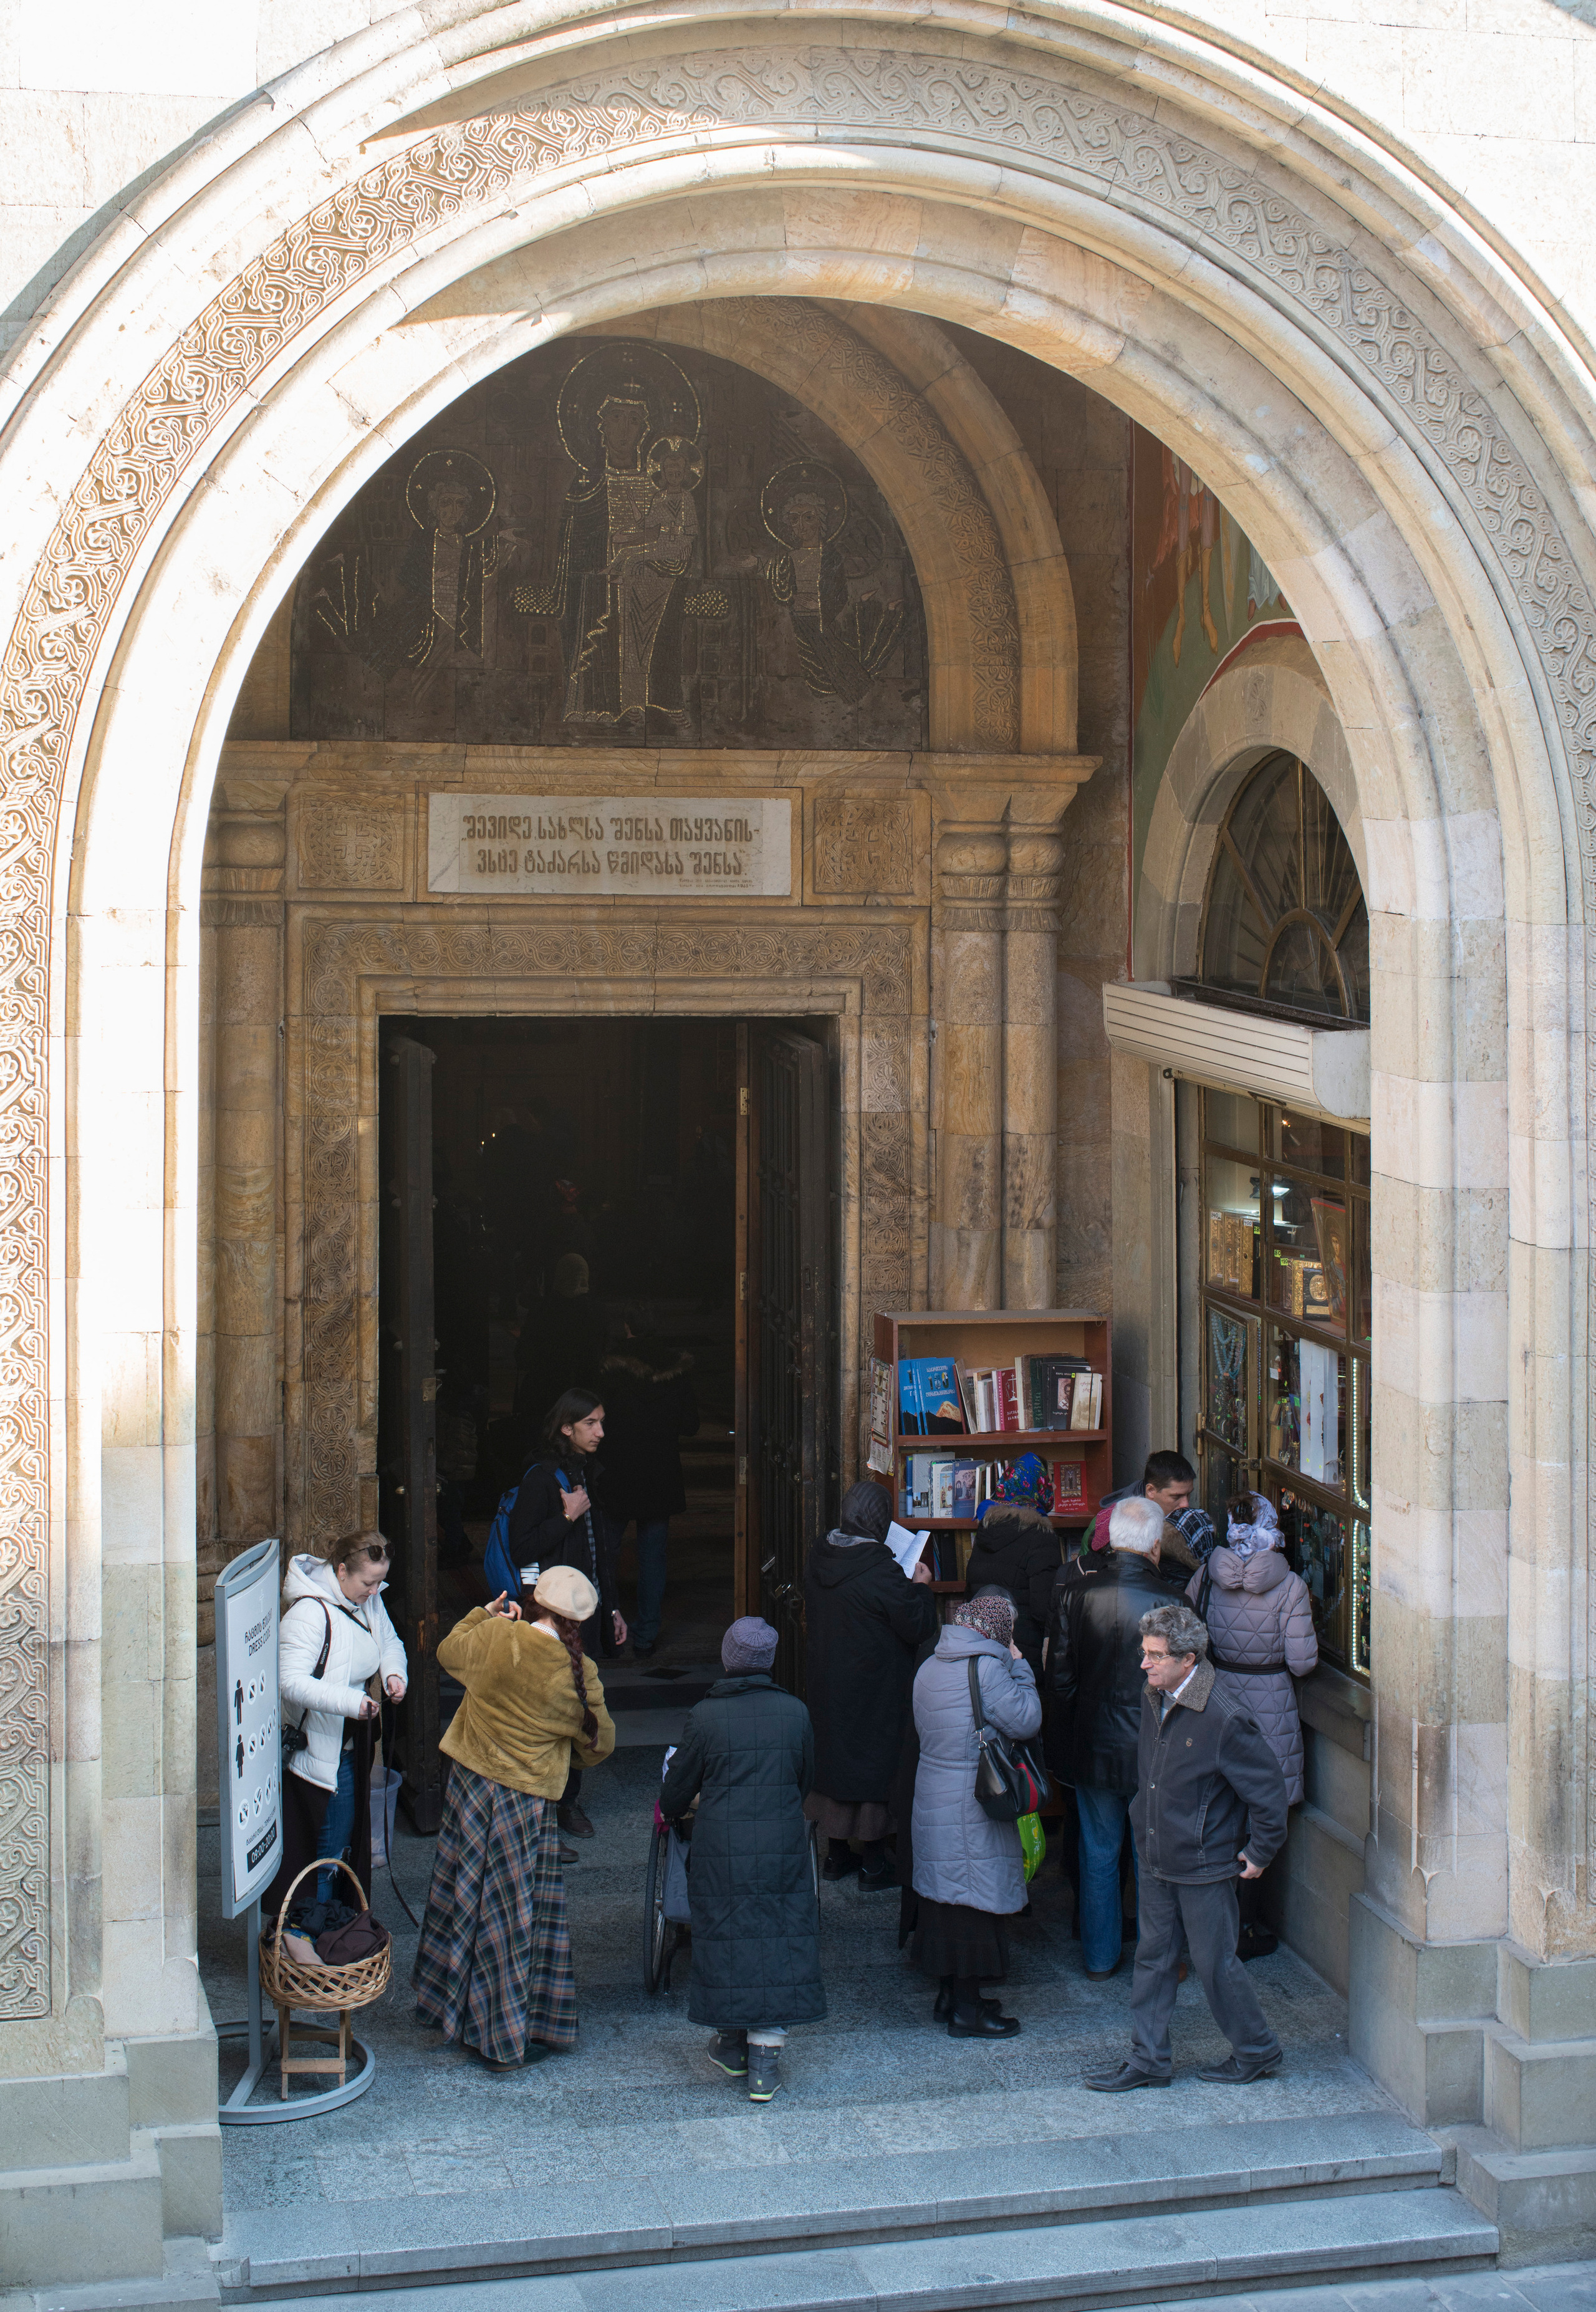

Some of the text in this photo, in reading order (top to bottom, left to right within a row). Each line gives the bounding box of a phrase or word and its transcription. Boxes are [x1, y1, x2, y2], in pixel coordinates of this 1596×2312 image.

[538, 816, 604, 841] სახლსა
[477, 849, 518, 874] ვსცე
[524, 849, 601, 874] ტაძარსა
[607, 850, 684, 875] წმიდასა
[249, 1635, 263, 1657] DRESS
[320, 1642, 329, 1665] Canon
[251, 1826, 276, 1863] 09:00-20:00
